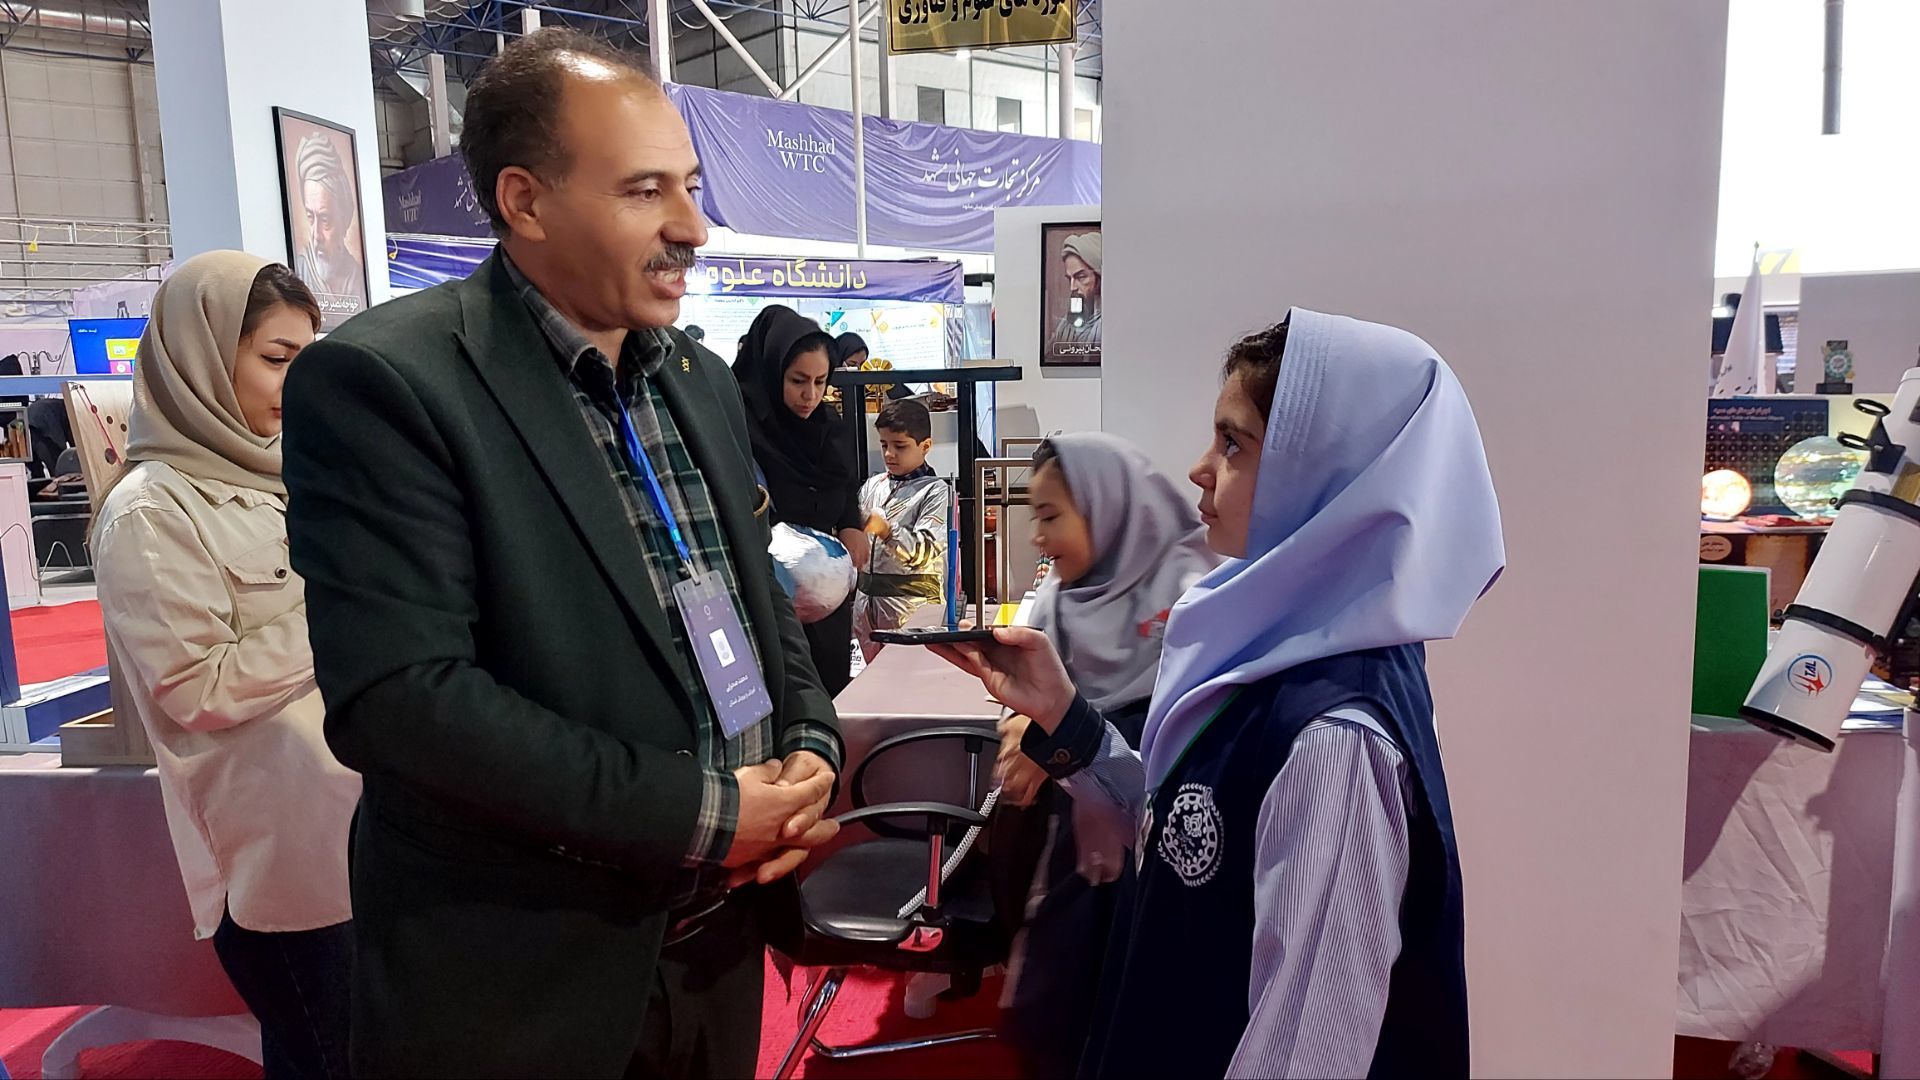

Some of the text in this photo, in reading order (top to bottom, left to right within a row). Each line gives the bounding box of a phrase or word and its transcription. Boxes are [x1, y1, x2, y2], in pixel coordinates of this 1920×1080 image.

[766, 128, 836, 156] Mashhad
[779, 150, 825, 173] WTC
[921, 147, 1042, 202] مرکز تجارت جهانی مشهد
[705, 258, 766, 293] علوم
[771, 258, 868, 289] دانشگاه
[1804, 660, 1817, 678] TAL
